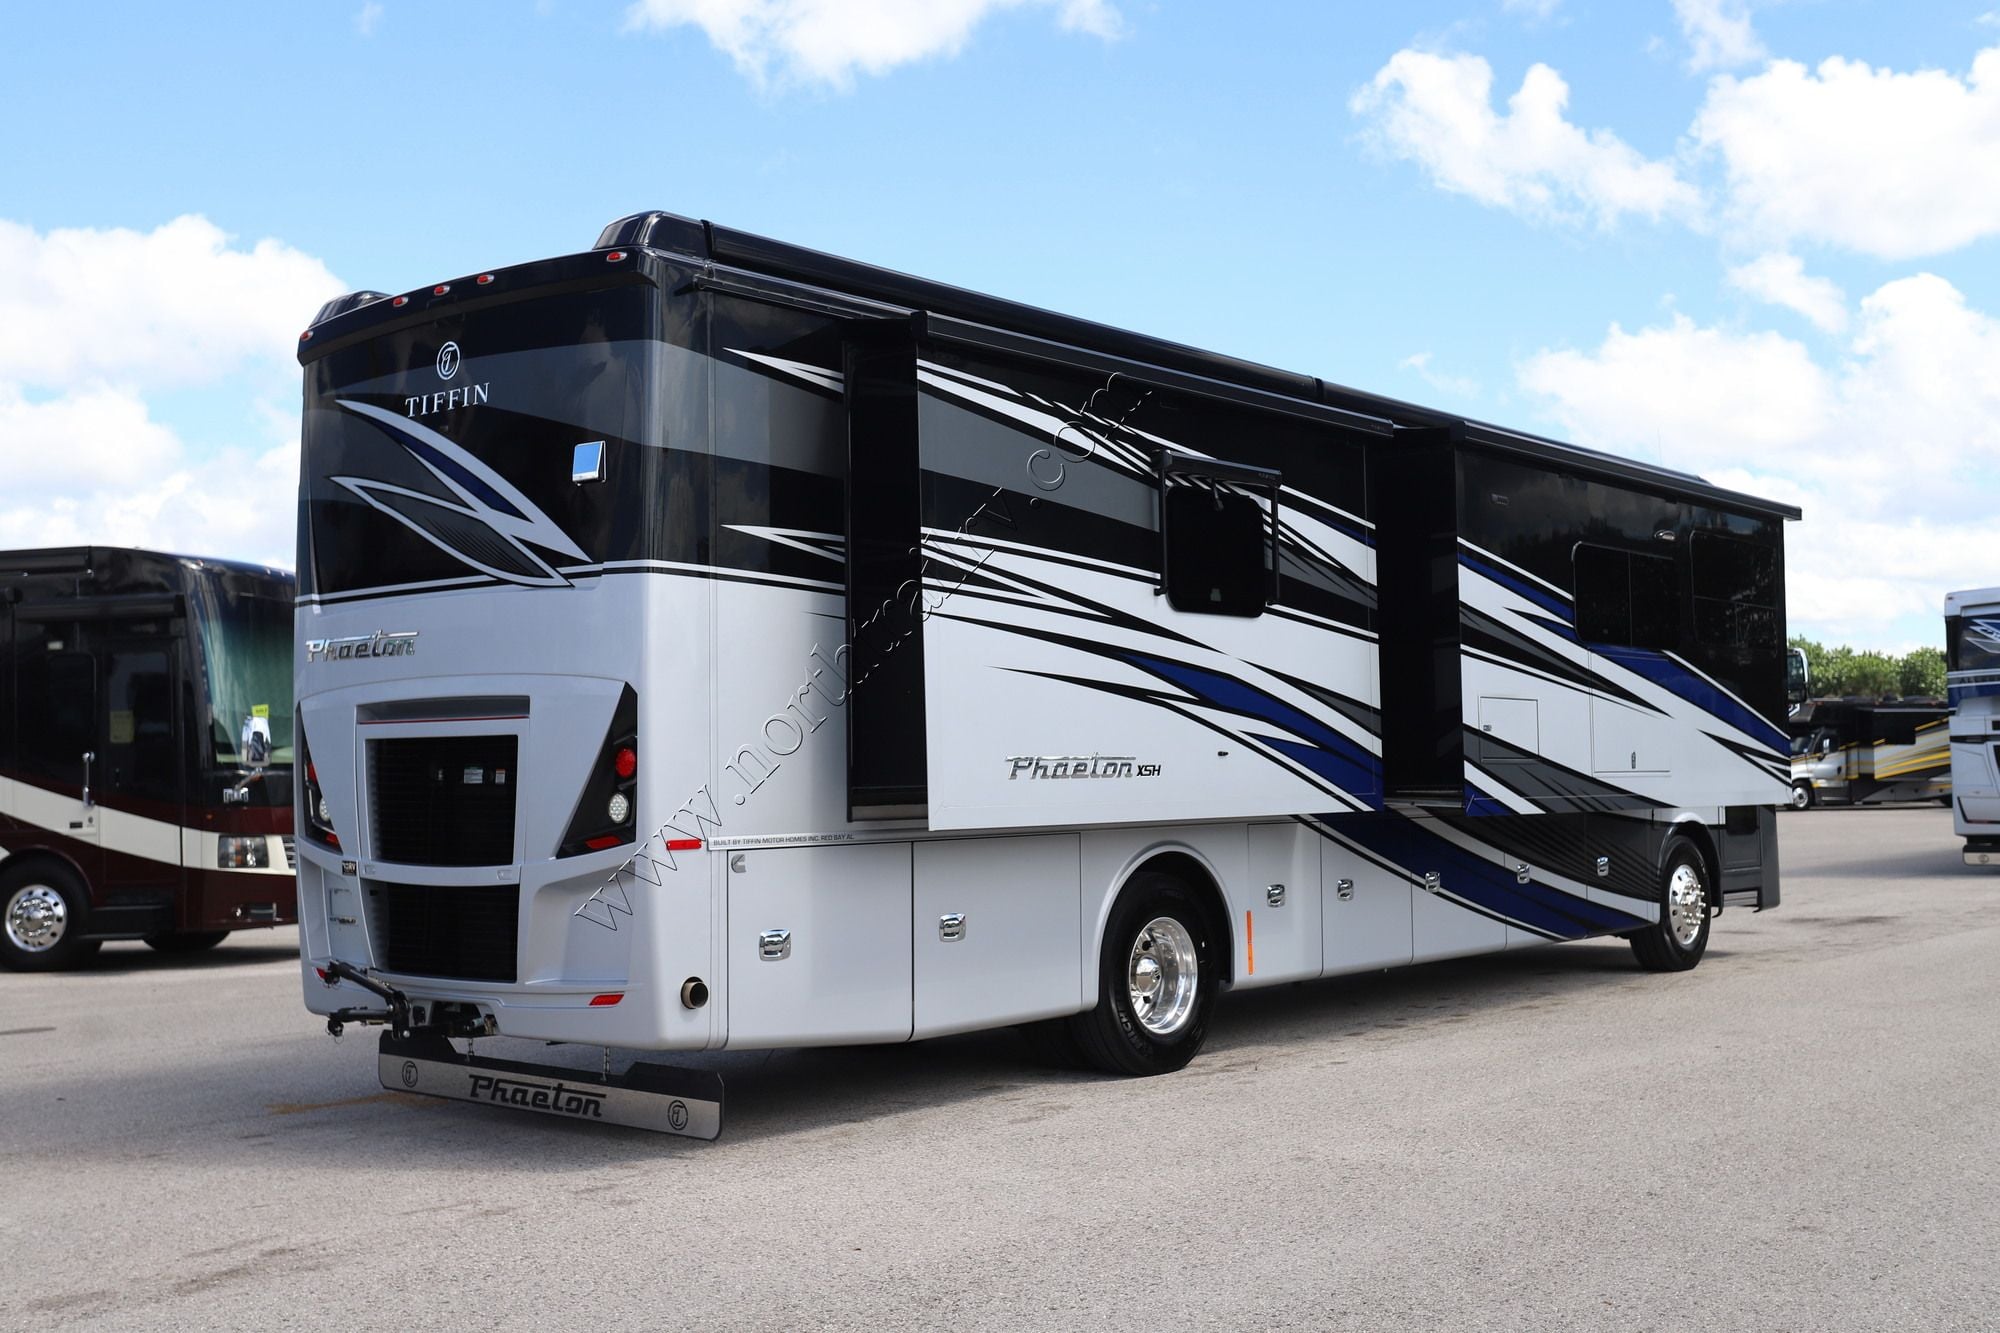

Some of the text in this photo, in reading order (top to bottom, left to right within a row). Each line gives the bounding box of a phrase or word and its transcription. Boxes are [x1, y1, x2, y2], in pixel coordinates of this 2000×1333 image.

[405, 382, 489, 418] TIFFIN
[305, 629, 419, 662] Phaeton
[1005, 752, 1162, 780] Phaeton XSH
[468, 1074, 607, 1118] Phaeton
